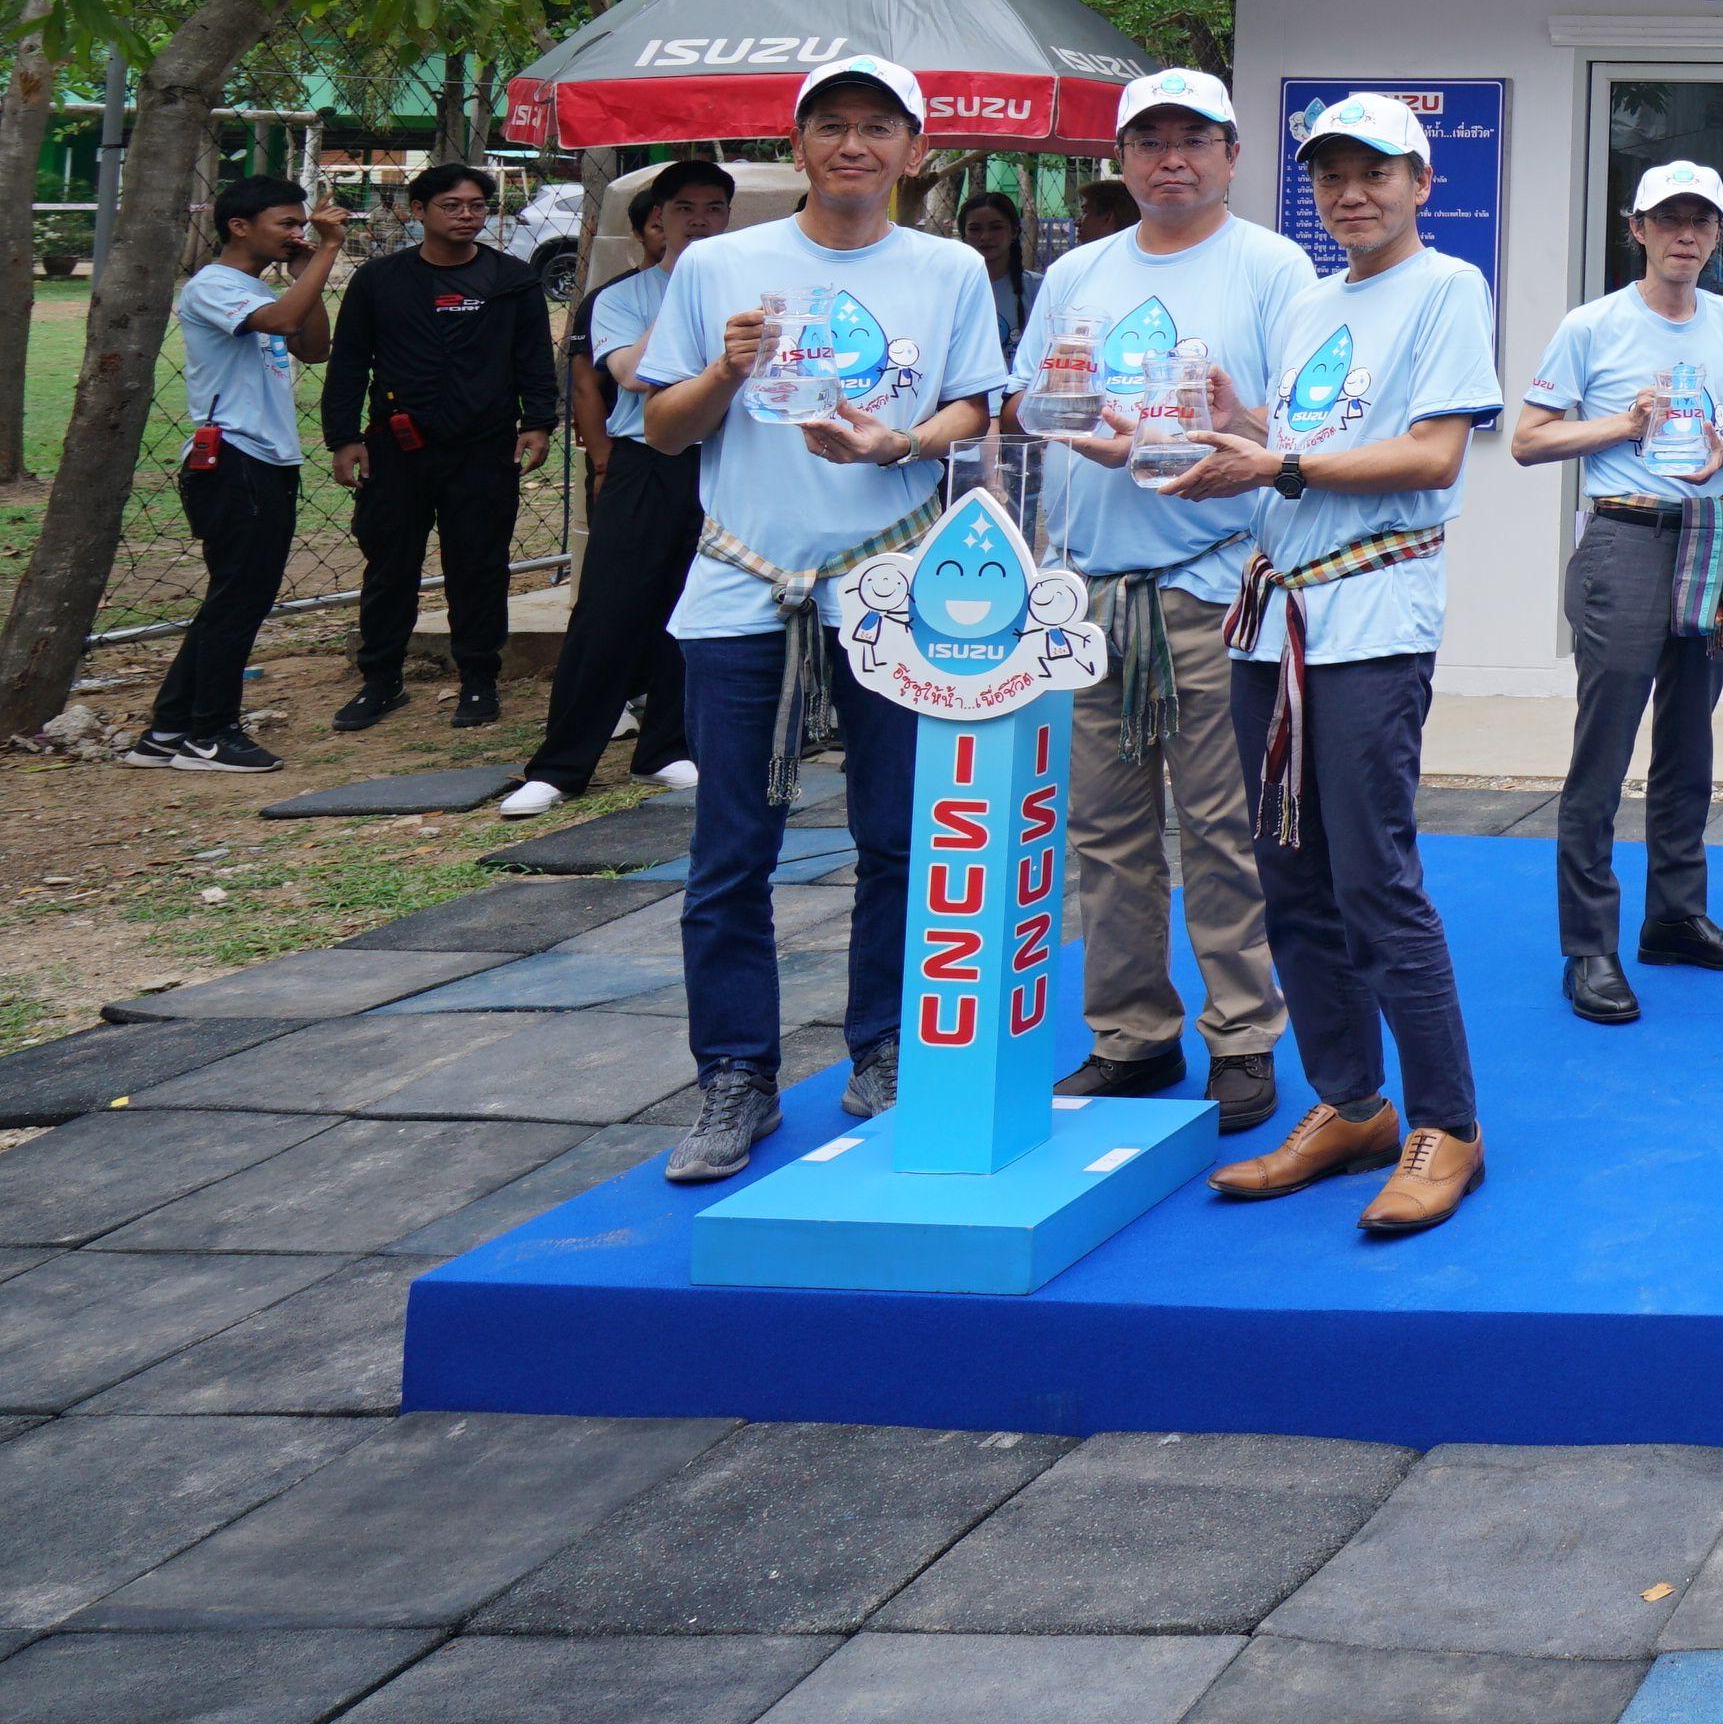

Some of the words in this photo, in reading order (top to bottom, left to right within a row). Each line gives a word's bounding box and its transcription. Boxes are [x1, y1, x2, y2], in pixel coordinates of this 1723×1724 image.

[634, 36, 848, 67] ISUZU
[1050, 45, 1149, 79] ISUZU
[1388, 95, 1440, 111] UZU
[1107, 376, 1145, 385] ISUZ
[1139, 406, 1195, 420] SUZU
[1292, 411, 1329, 422] ISUZU
[1665, 408, 1705, 421] ISUZ
[928, 643, 1004, 660] ISUZU
[1010, 724, 1058, 1037] ISUZU
[918, 733, 990, 1048] ISUZU
